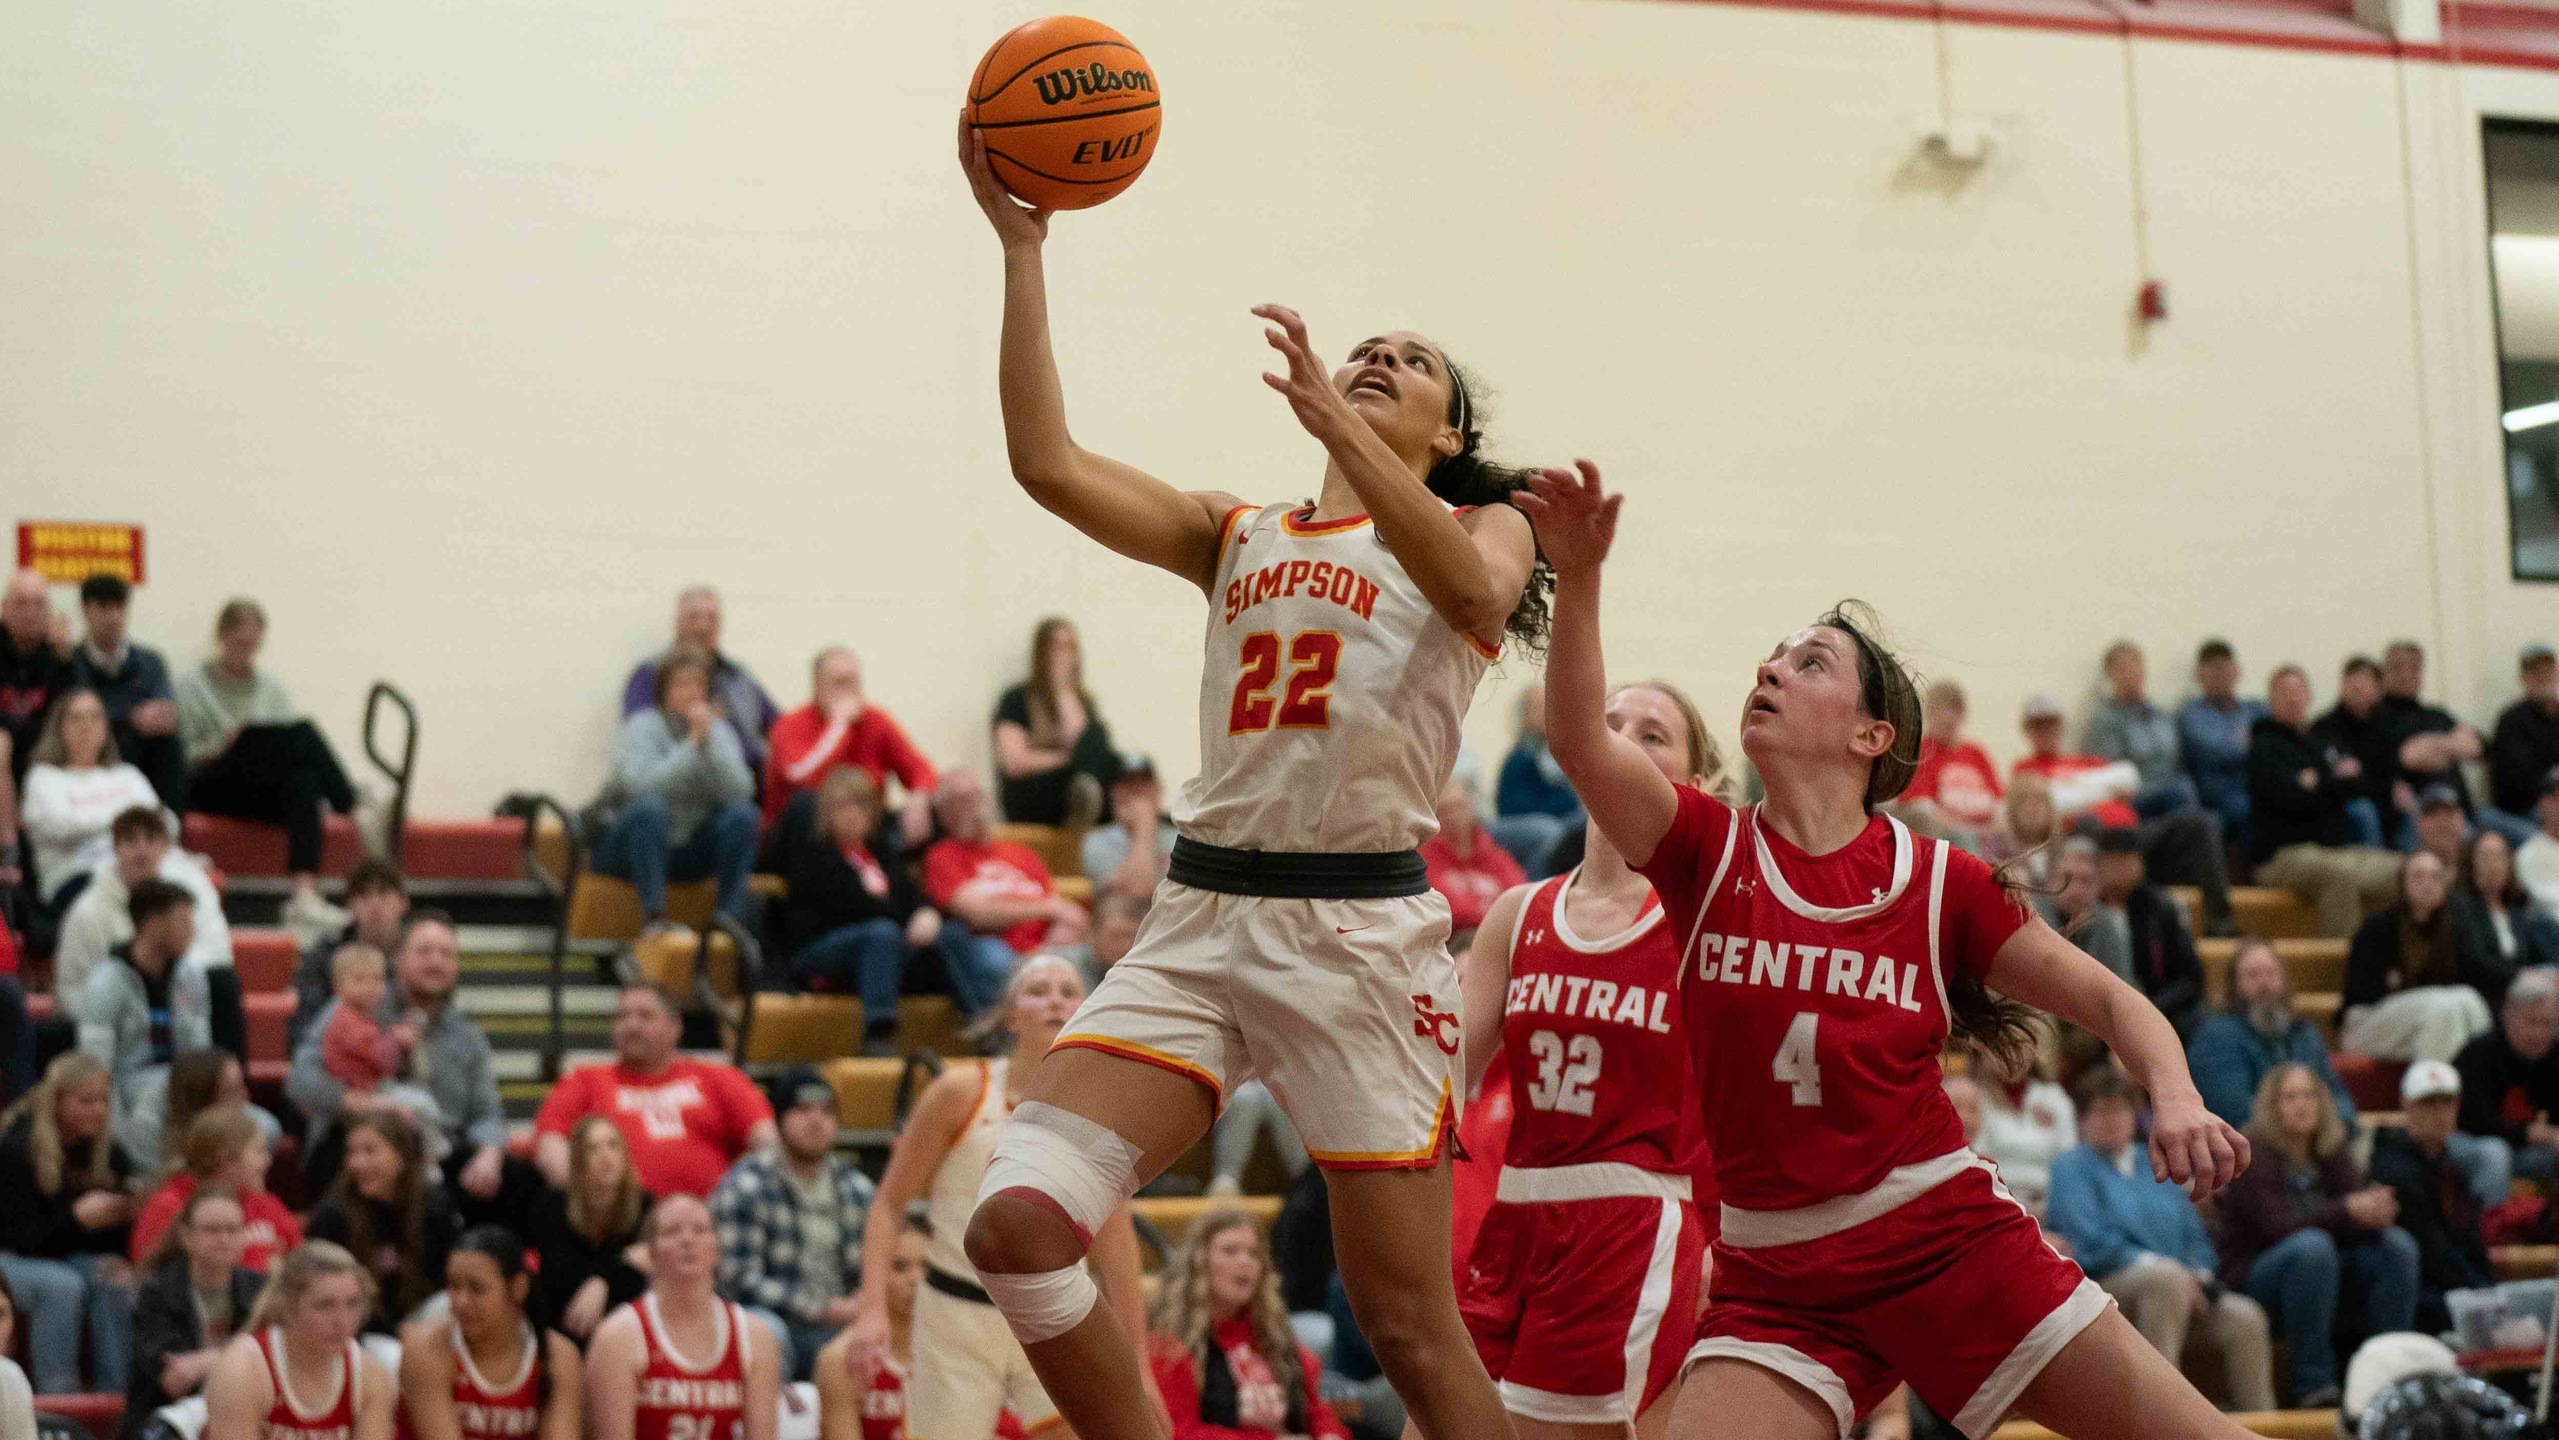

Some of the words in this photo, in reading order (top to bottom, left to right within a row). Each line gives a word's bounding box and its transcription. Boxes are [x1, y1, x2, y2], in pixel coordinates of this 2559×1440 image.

[1033, 61, 1153, 105] Wilson
[1072, 130, 1144, 165] EVO
[1226, 560, 1380, 625] SIMPSON
[1228, 630, 1344, 736] 22
[1504, 973, 1671, 1034] CENTRAL
[1700, 932, 1922, 1014] CENTRAL
[1411, 994, 1460, 1056] SC
[1527, 1029, 1603, 1118] 32
[1772, 1011, 1823, 1107] 4
